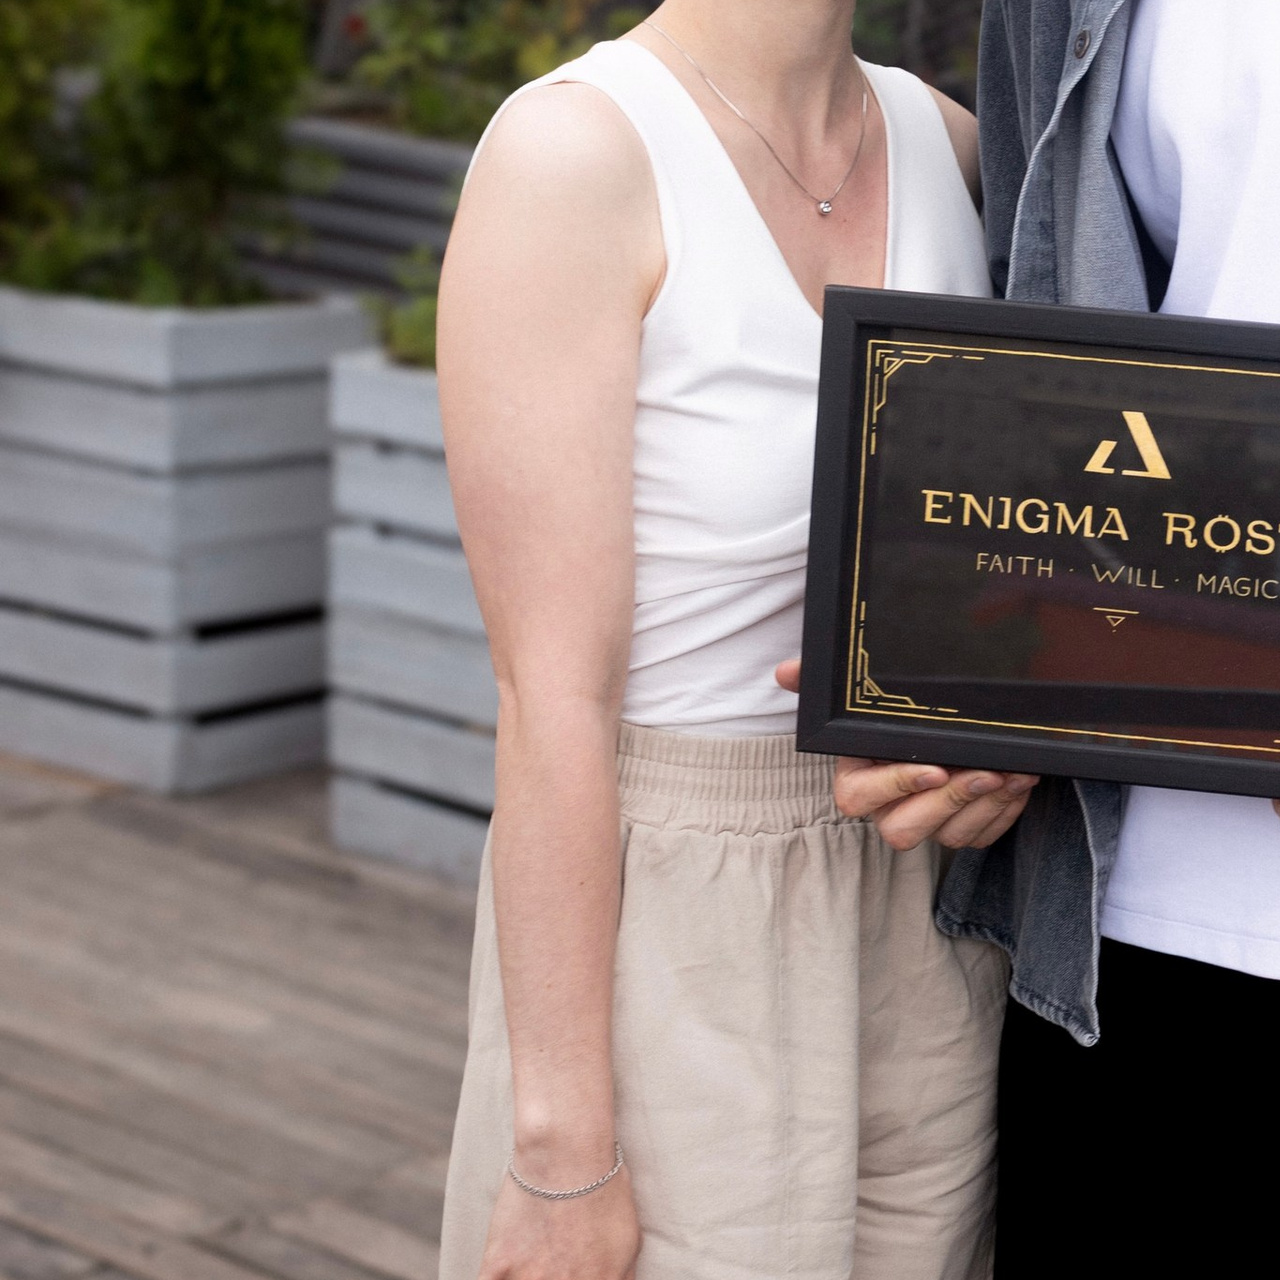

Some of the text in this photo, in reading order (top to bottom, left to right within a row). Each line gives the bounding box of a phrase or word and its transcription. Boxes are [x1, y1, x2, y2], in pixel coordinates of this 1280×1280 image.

[921, 489, 1129, 541] ENIGMA
[976, 552, 1279, 599] FAITH WILL MAGIC
